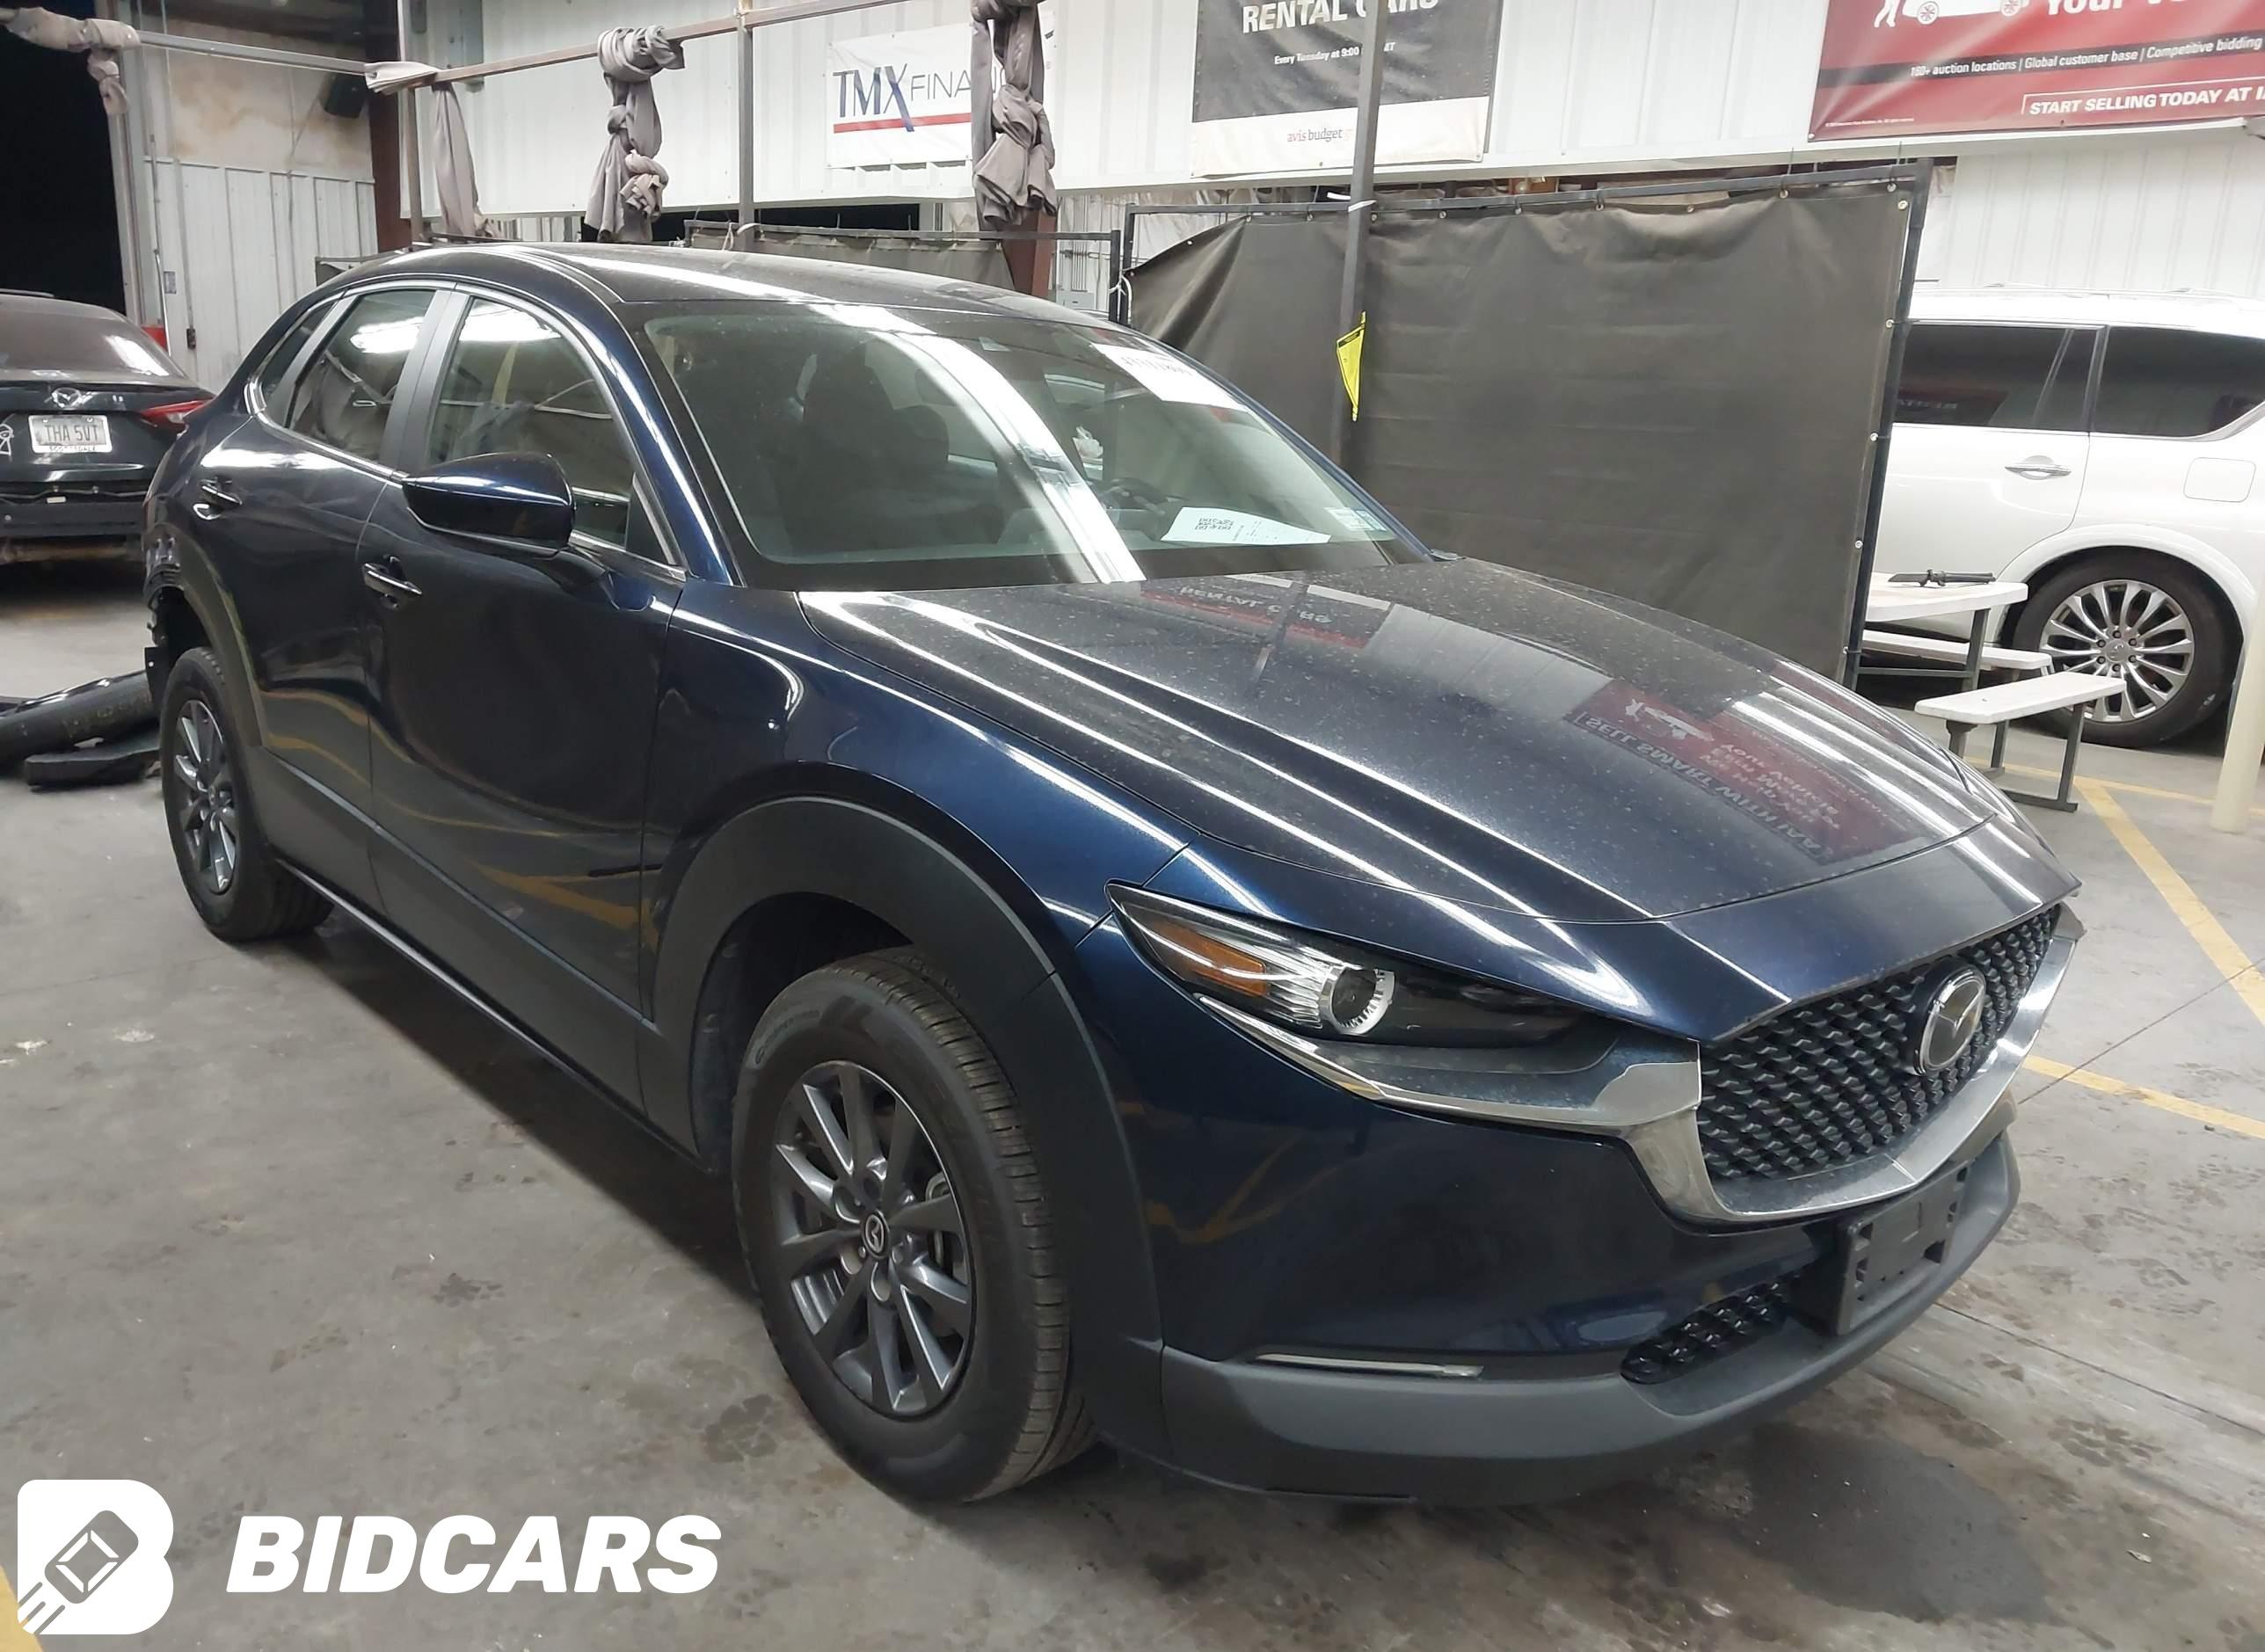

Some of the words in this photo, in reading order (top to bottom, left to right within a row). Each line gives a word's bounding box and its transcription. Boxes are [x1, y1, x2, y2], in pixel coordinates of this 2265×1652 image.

[1242, 0, 1348, 33] RENTAL
[1274, 55, 1295, 64] Every
[1341, 47, 1359, 56] 9:00
[1933, 62, 1970, 75] auction
[1971, 60, 2017, 73] locations
[2025, 55, 2057, 69] Global
[2059, 53, 2109, 67] customer
[2111, 49, 2138, 62] base
[2146, 41, 2214, 59] Competitive
[2216, 35, 2263, 52] bidding
[833, 63, 914, 132] TMX
[911, 66, 1005, 101] FINA
[2029, 99, 2083, 115] START
[2085, 93, 2157, 112] SELLING
[2159, 89, 2223, 106] TODAY
[2225, 86, 2253, 103] AT
[1287, 129, 1307, 142] avis
[1308, 127, 1344, 142] budget
[45, 425, 70, 441] THA
